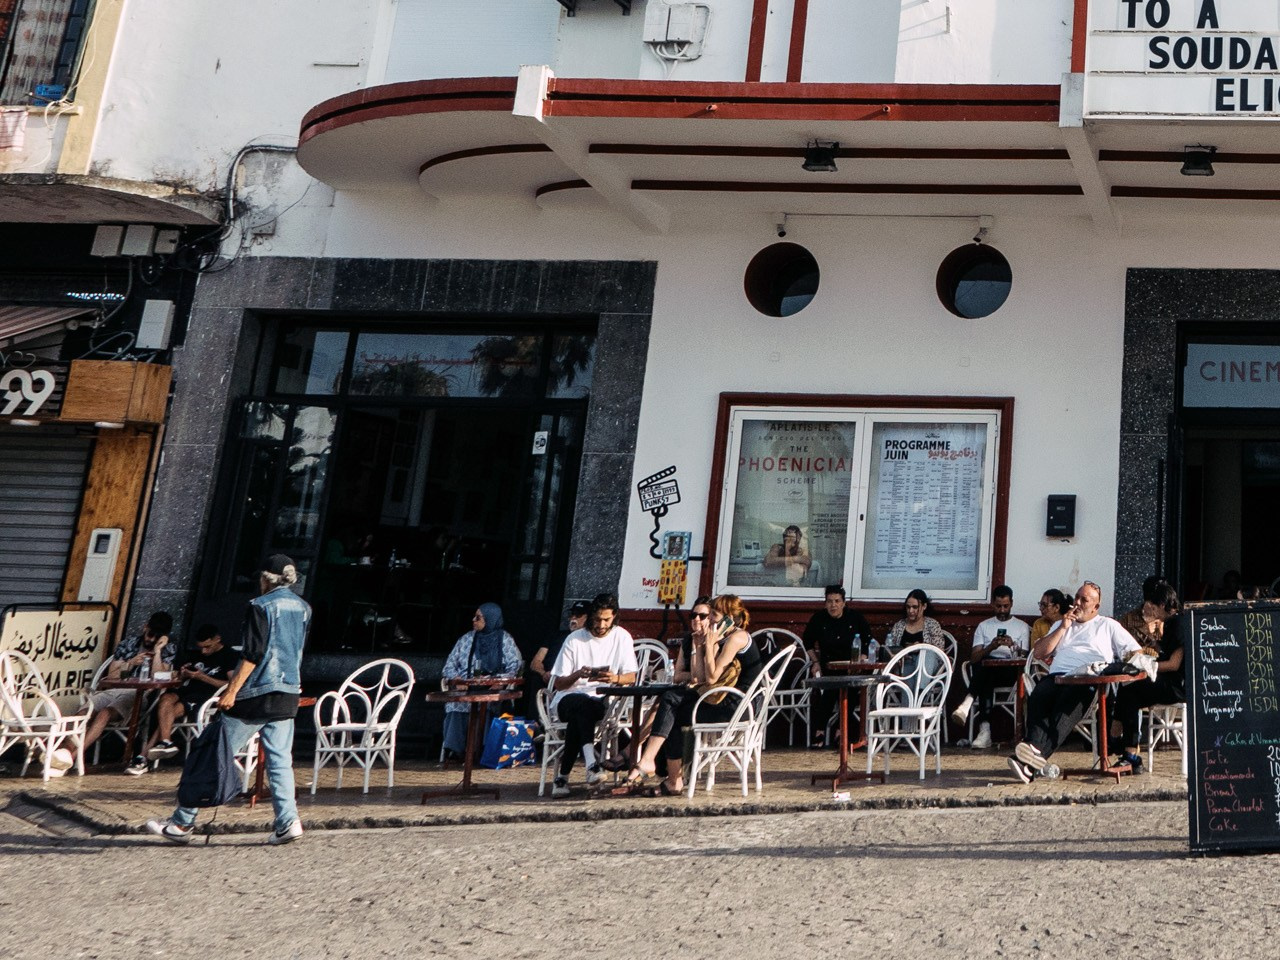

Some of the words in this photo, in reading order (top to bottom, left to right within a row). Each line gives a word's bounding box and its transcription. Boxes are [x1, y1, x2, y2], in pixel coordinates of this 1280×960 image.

[885, 439, 951, 451] PROGRAMME
[884, 450, 909, 461] JUIN
[776, 477, 817, 485] SCHEME
[1200, 617, 1227, 630] Soda
